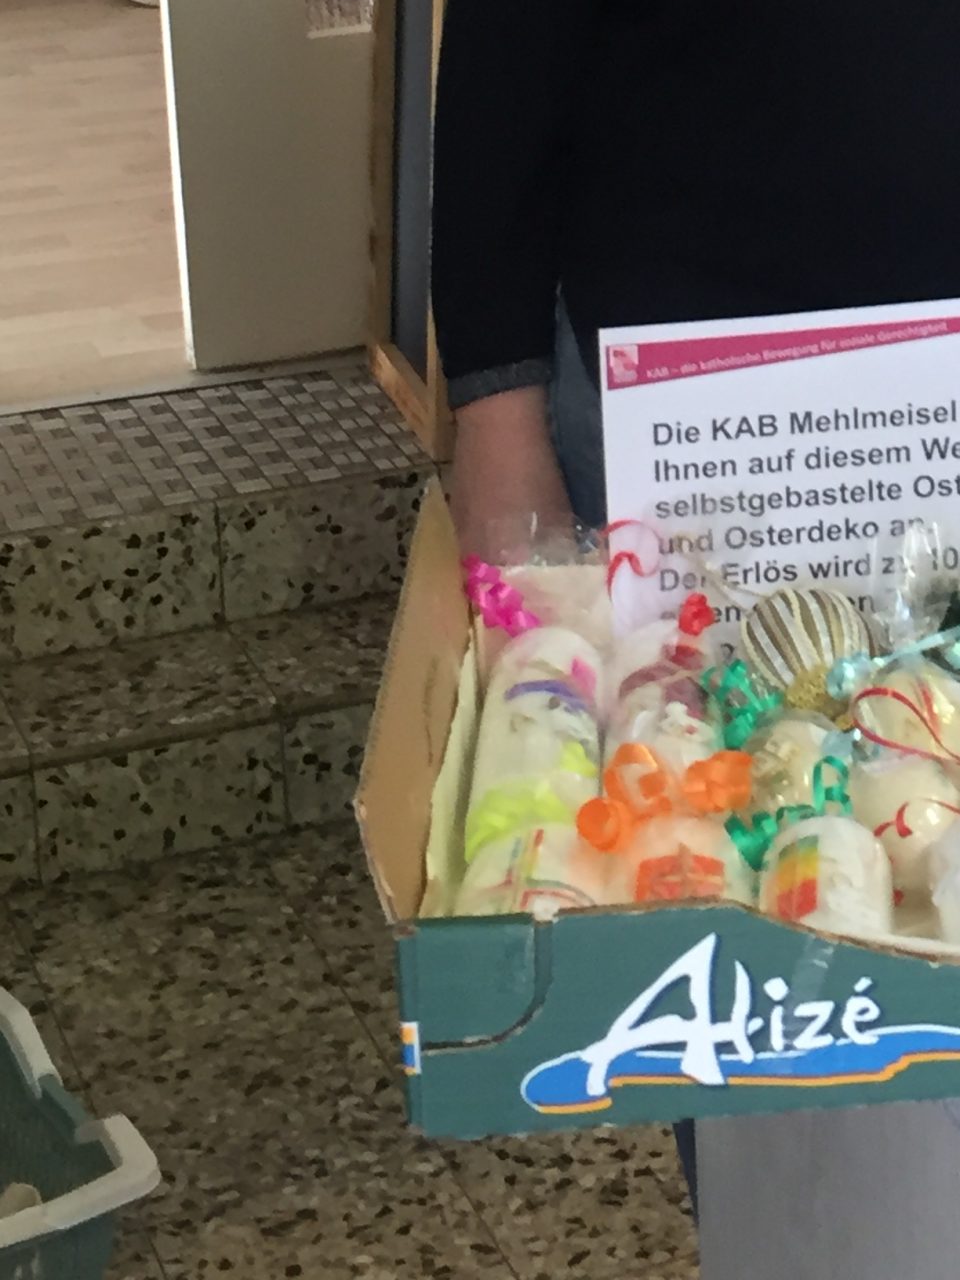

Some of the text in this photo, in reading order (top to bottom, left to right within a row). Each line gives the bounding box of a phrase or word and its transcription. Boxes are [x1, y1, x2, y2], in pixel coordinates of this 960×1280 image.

[652, 421, 701, 447] Die
[711, 413, 779, 442] KAB
[788, 399, 957, 435] Mehlmeisel
[653, 458, 737, 483] Ihnen
[748, 448, 796, 475] auf
[804, 444, 911, 470] diesem
[655, 478, 903, 520] selbstgebastelte
[658, 528, 714, 556] und
[724, 518, 879, 550] Osterdeko
[659, 567, 707, 592] Der
[721, 559, 798, 587] Erlös
[808, 552, 872, 580] wird
[586, 931, 881, 1098] Alizé
